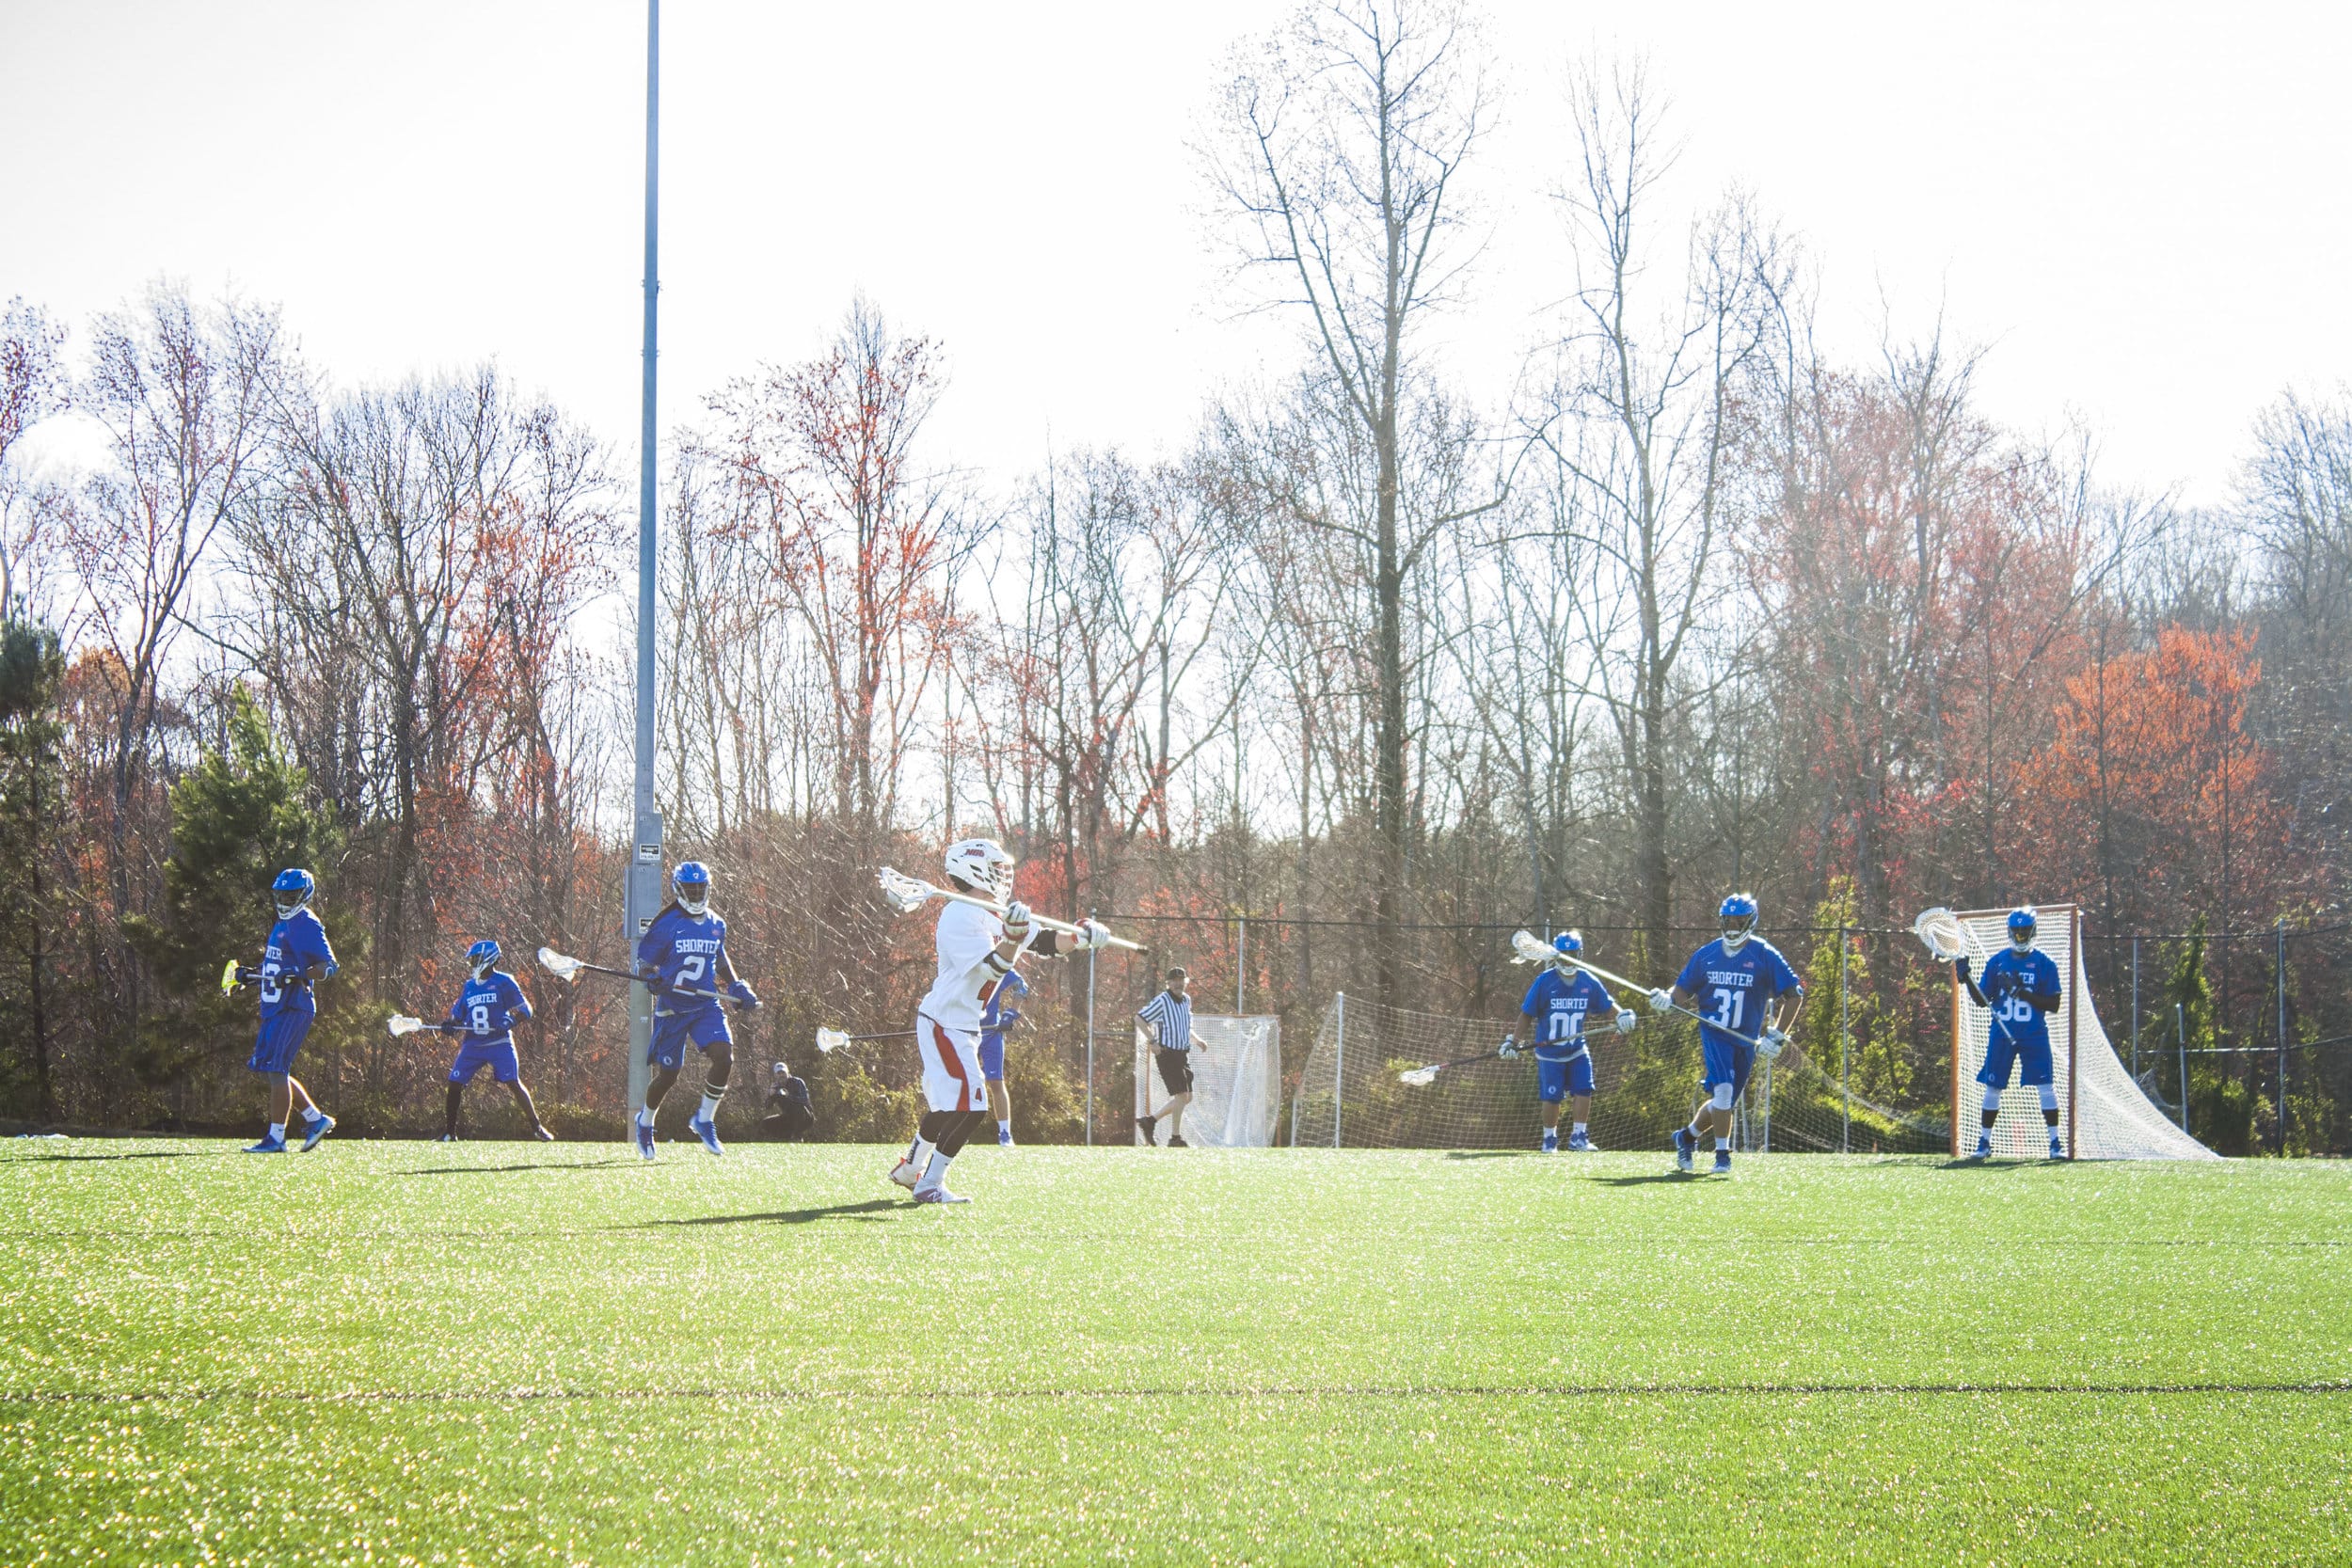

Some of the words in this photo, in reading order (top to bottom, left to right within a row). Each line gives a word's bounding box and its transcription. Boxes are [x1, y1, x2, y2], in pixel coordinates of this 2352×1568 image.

[673, 956, 706, 996] 2
[1707, 971, 1754, 987] SHORTER
[471, 1006, 489, 1035] 8
[1708, 988, 1745, 1028] 31
